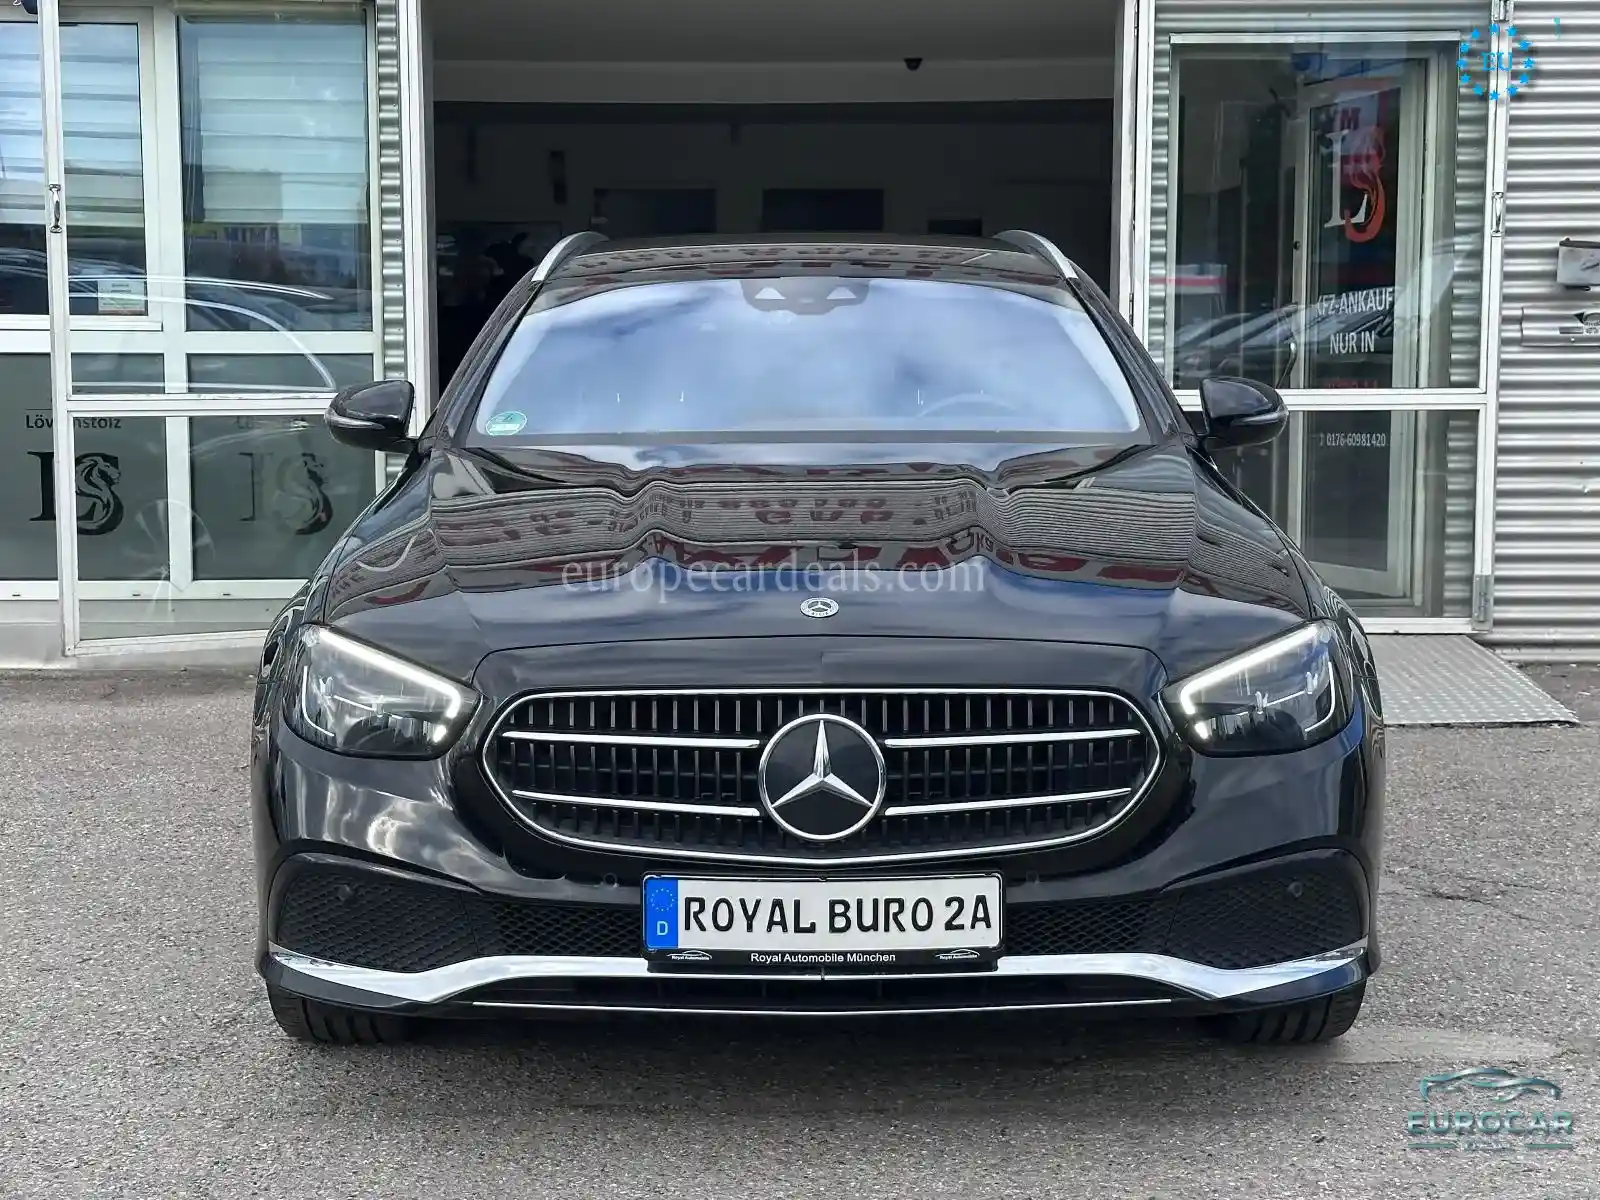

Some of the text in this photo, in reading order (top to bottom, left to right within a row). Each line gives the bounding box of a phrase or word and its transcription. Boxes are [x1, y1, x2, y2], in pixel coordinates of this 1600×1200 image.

[1330, 330, 1375, 355] NUR IN
[684, 894, 992, 934] ROYAL BURO 2A
[656, 920, 669, 936] D
[750, 952, 896, 965] Royal Automobile München
